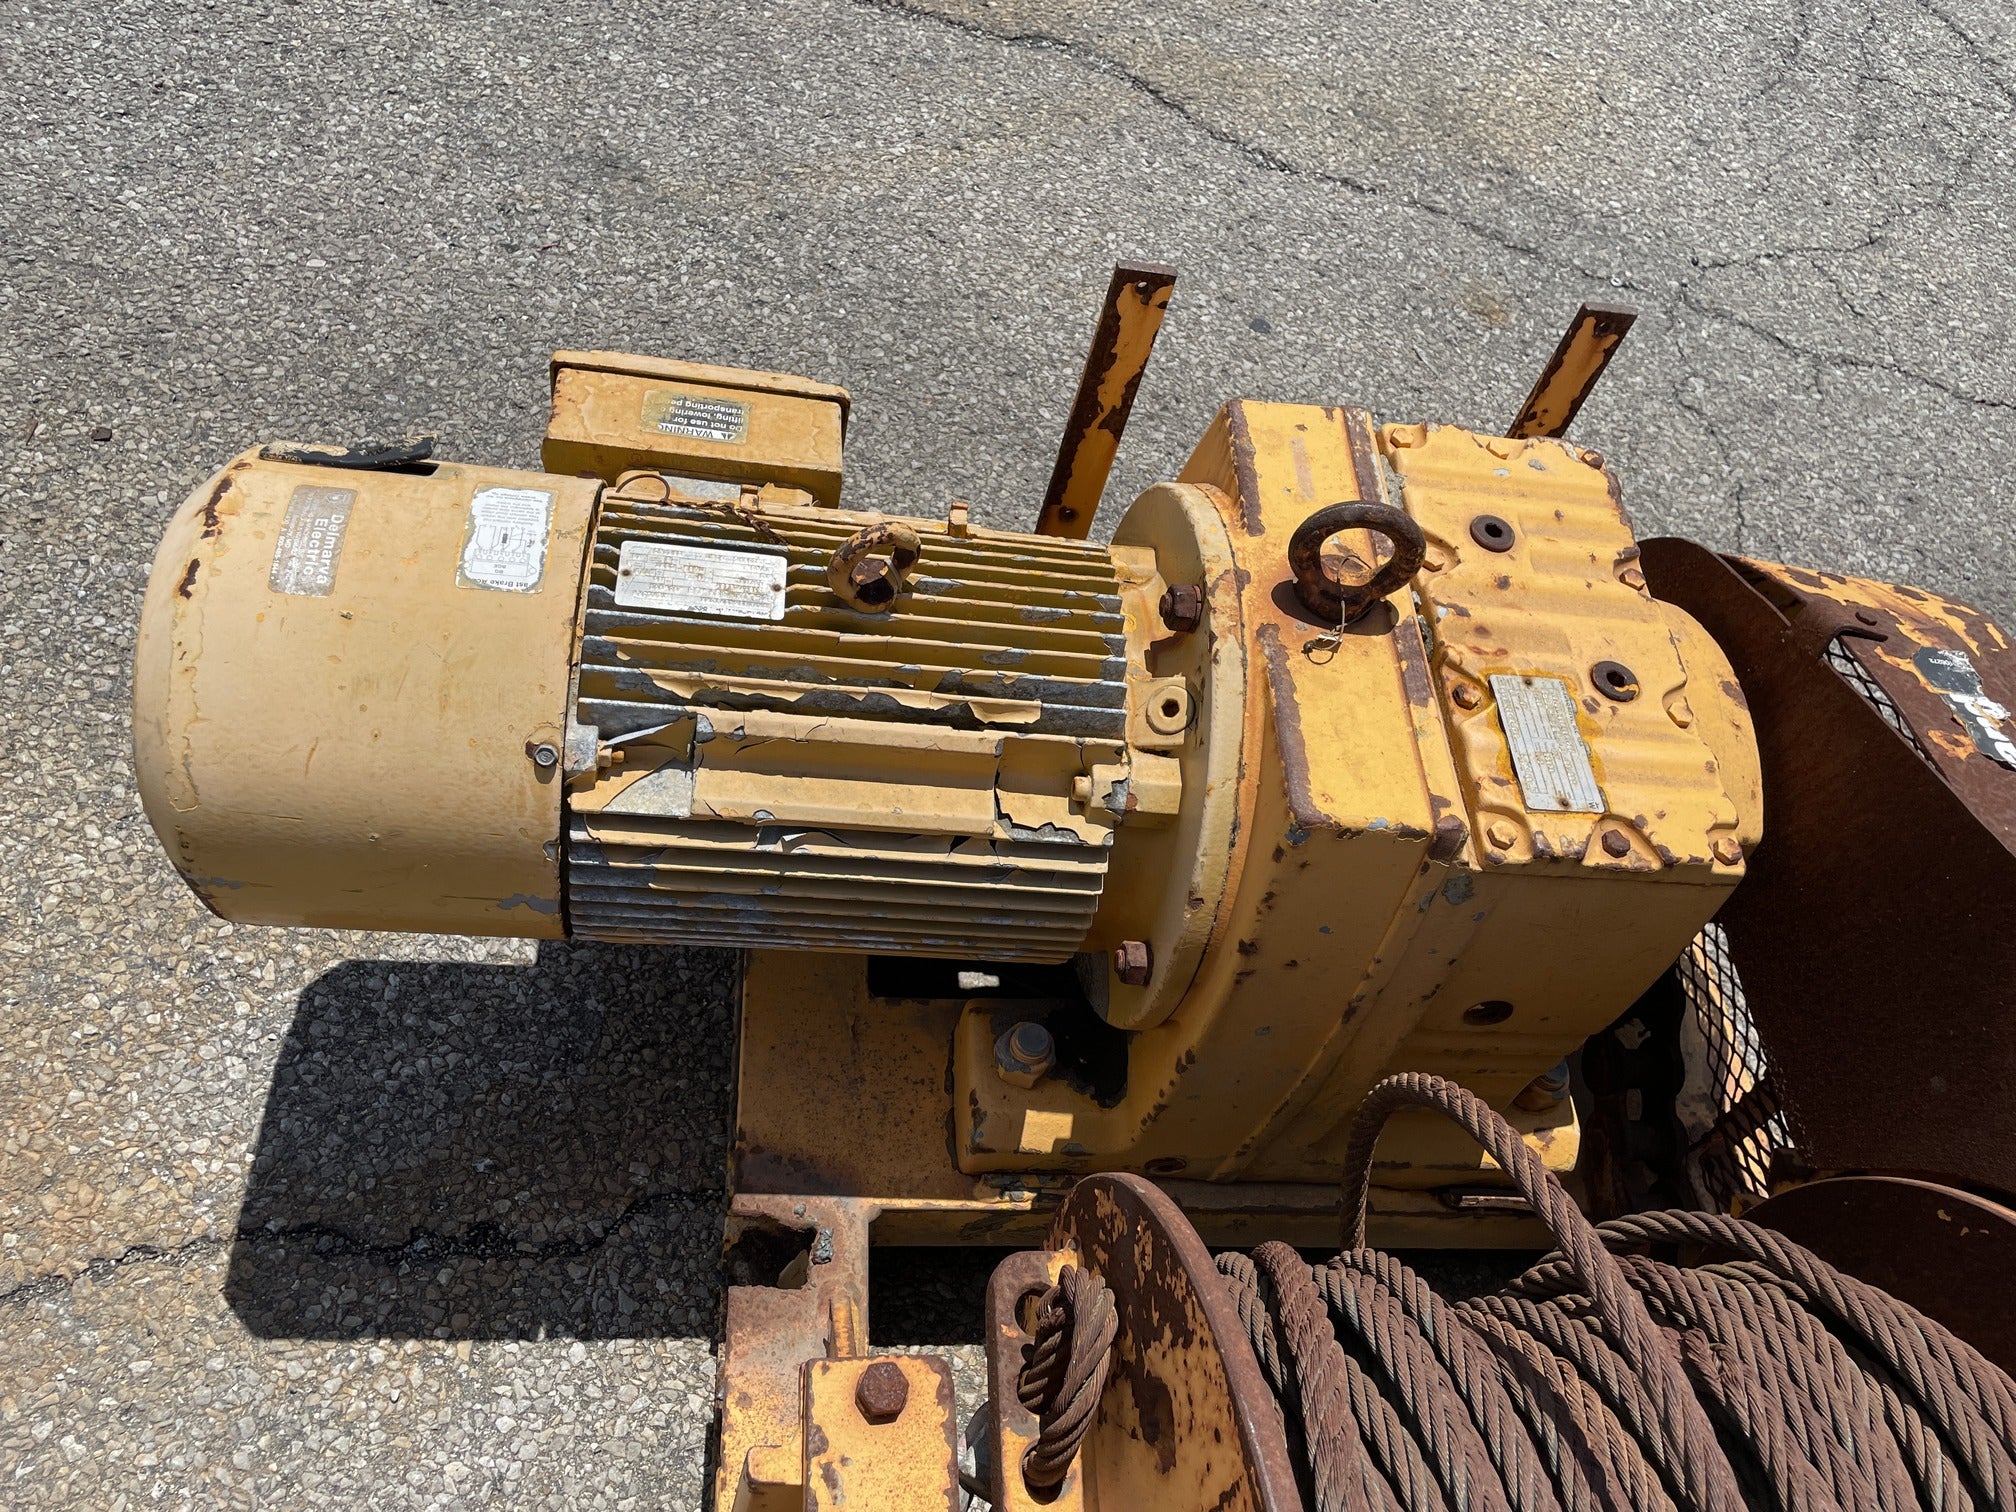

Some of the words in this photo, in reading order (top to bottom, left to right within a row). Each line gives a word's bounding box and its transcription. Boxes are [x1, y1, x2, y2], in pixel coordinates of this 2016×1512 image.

[685, 400, 744, 415] transporting
[669, 406, 711, 419] lowering
[673, 416, 688, 424] for
[690, 418, 708, 426] use
[711, 421, 727, 429] not
[729, 424, 743, 432] Do
[303, 518, 329, 576] Electric
[316, 514, 345, 584] Delmarva
[491, 579, 514, 588] Brake
